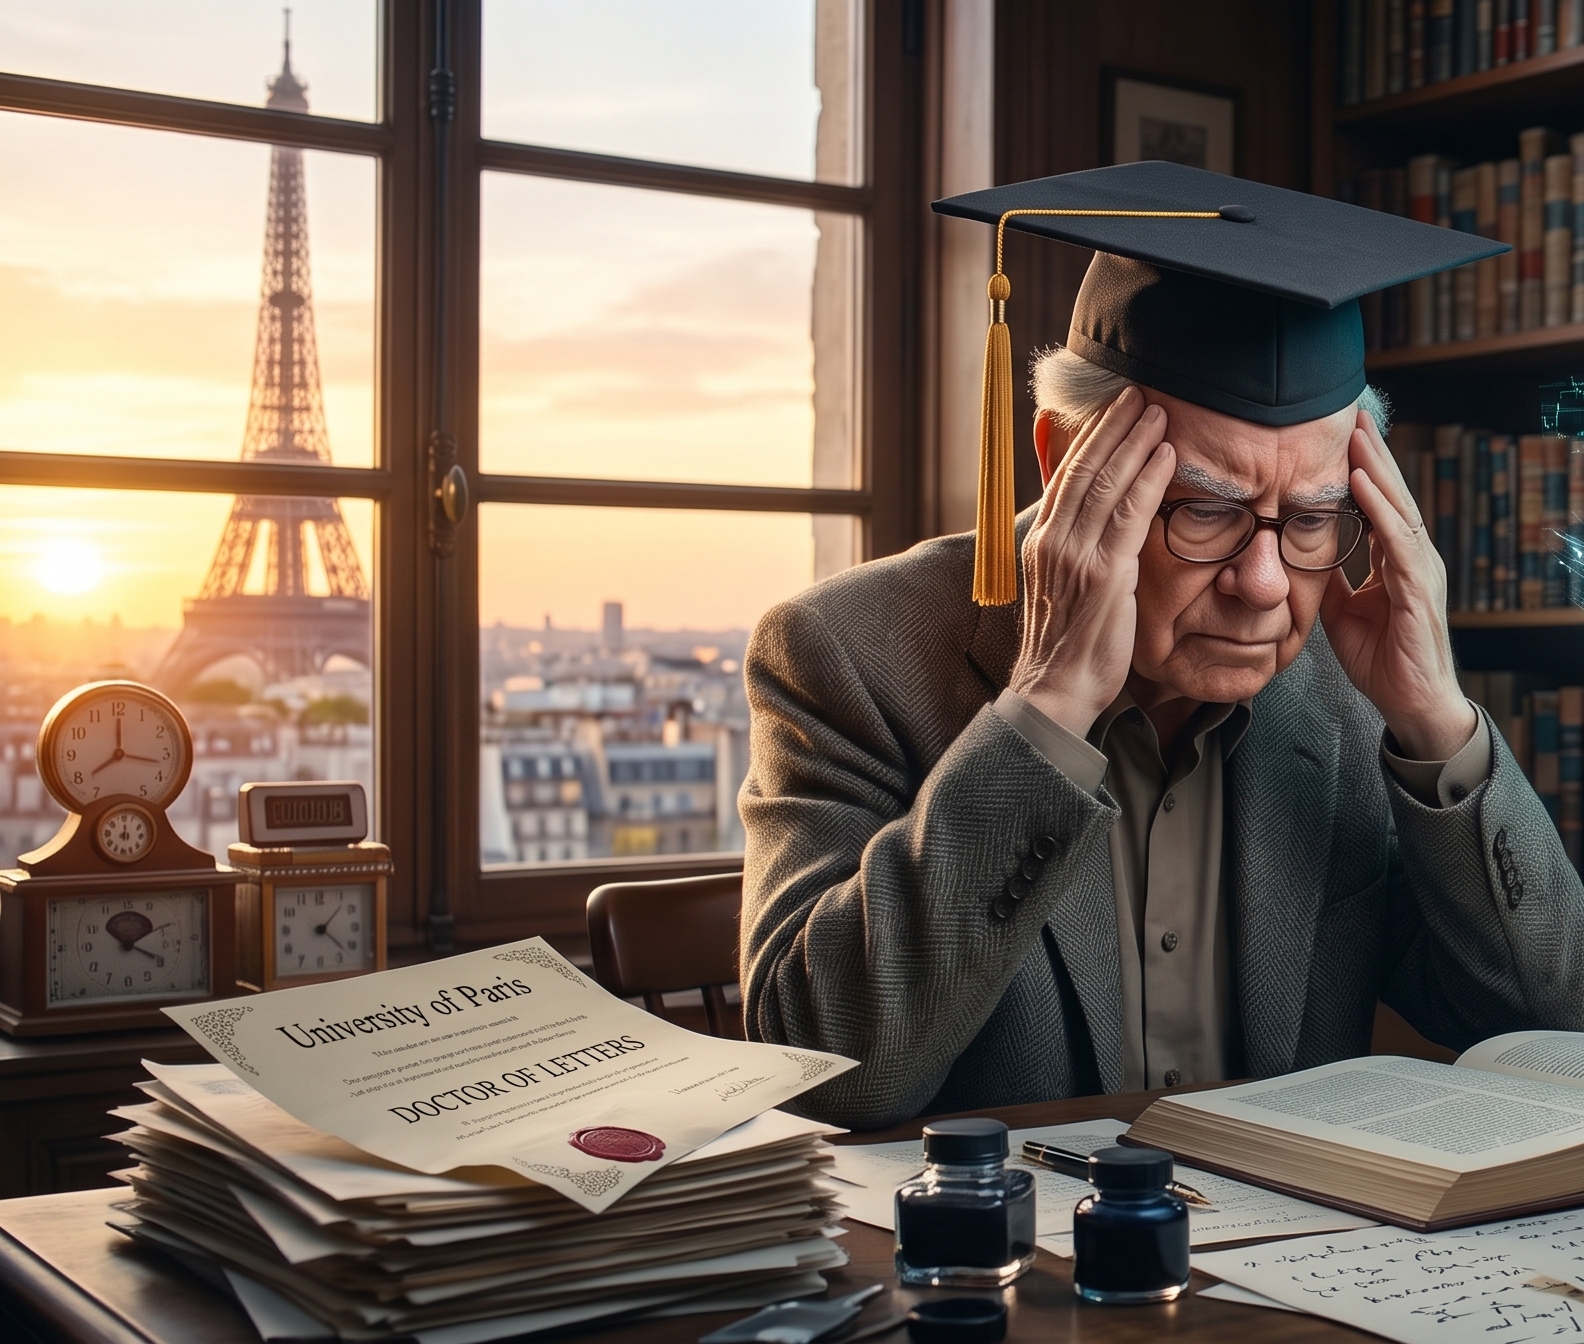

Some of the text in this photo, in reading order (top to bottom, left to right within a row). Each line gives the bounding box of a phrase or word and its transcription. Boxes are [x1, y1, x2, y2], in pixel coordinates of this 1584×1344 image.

[277, 1004, 431, 1049] University
[433, 987, 464, 1016] of
[458, 975, 532, 1009] Paris
[388, 1081, 511, 1125] DOCTOR
[501, 1067, 541, 1088] OF
[533, 1035, 646, 1078] LETTERS
